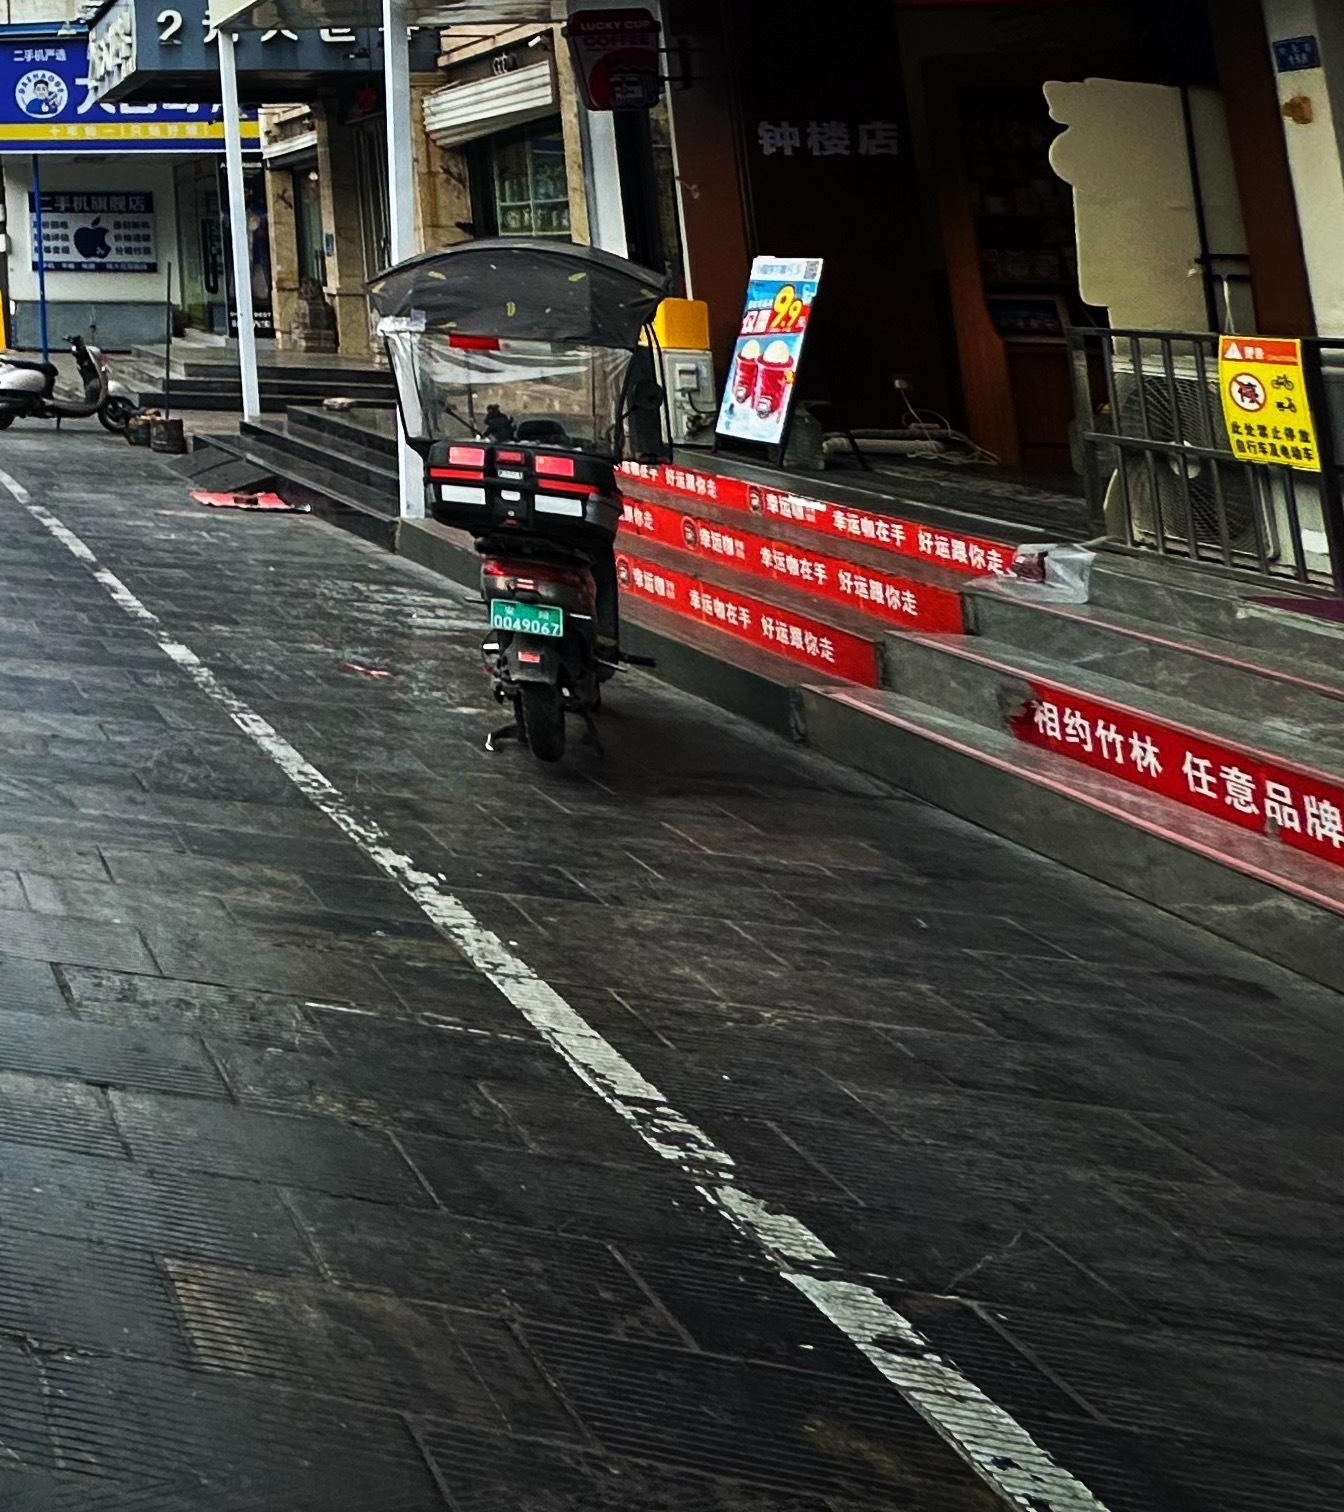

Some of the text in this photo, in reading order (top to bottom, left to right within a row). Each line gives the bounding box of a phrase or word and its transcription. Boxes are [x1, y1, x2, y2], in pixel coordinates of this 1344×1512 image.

[757, 120, 900, 157] 钟楼店
[831, 509, 907, 548] 幸运咖在手
[917, 529, 1006, 575] 好运跟你走
[759, 546, 828, 586] 幸运咖在手
[838, 568, 919, 617] 好运跟你走
[493, 614, 560, 636] 0049067
[688, 589, 752, 630] 幸运咖在手
[760, 615, 836, 664] 好运跟你走
[1033, 700, 1344, 849] 相约竹林 任意品牌
